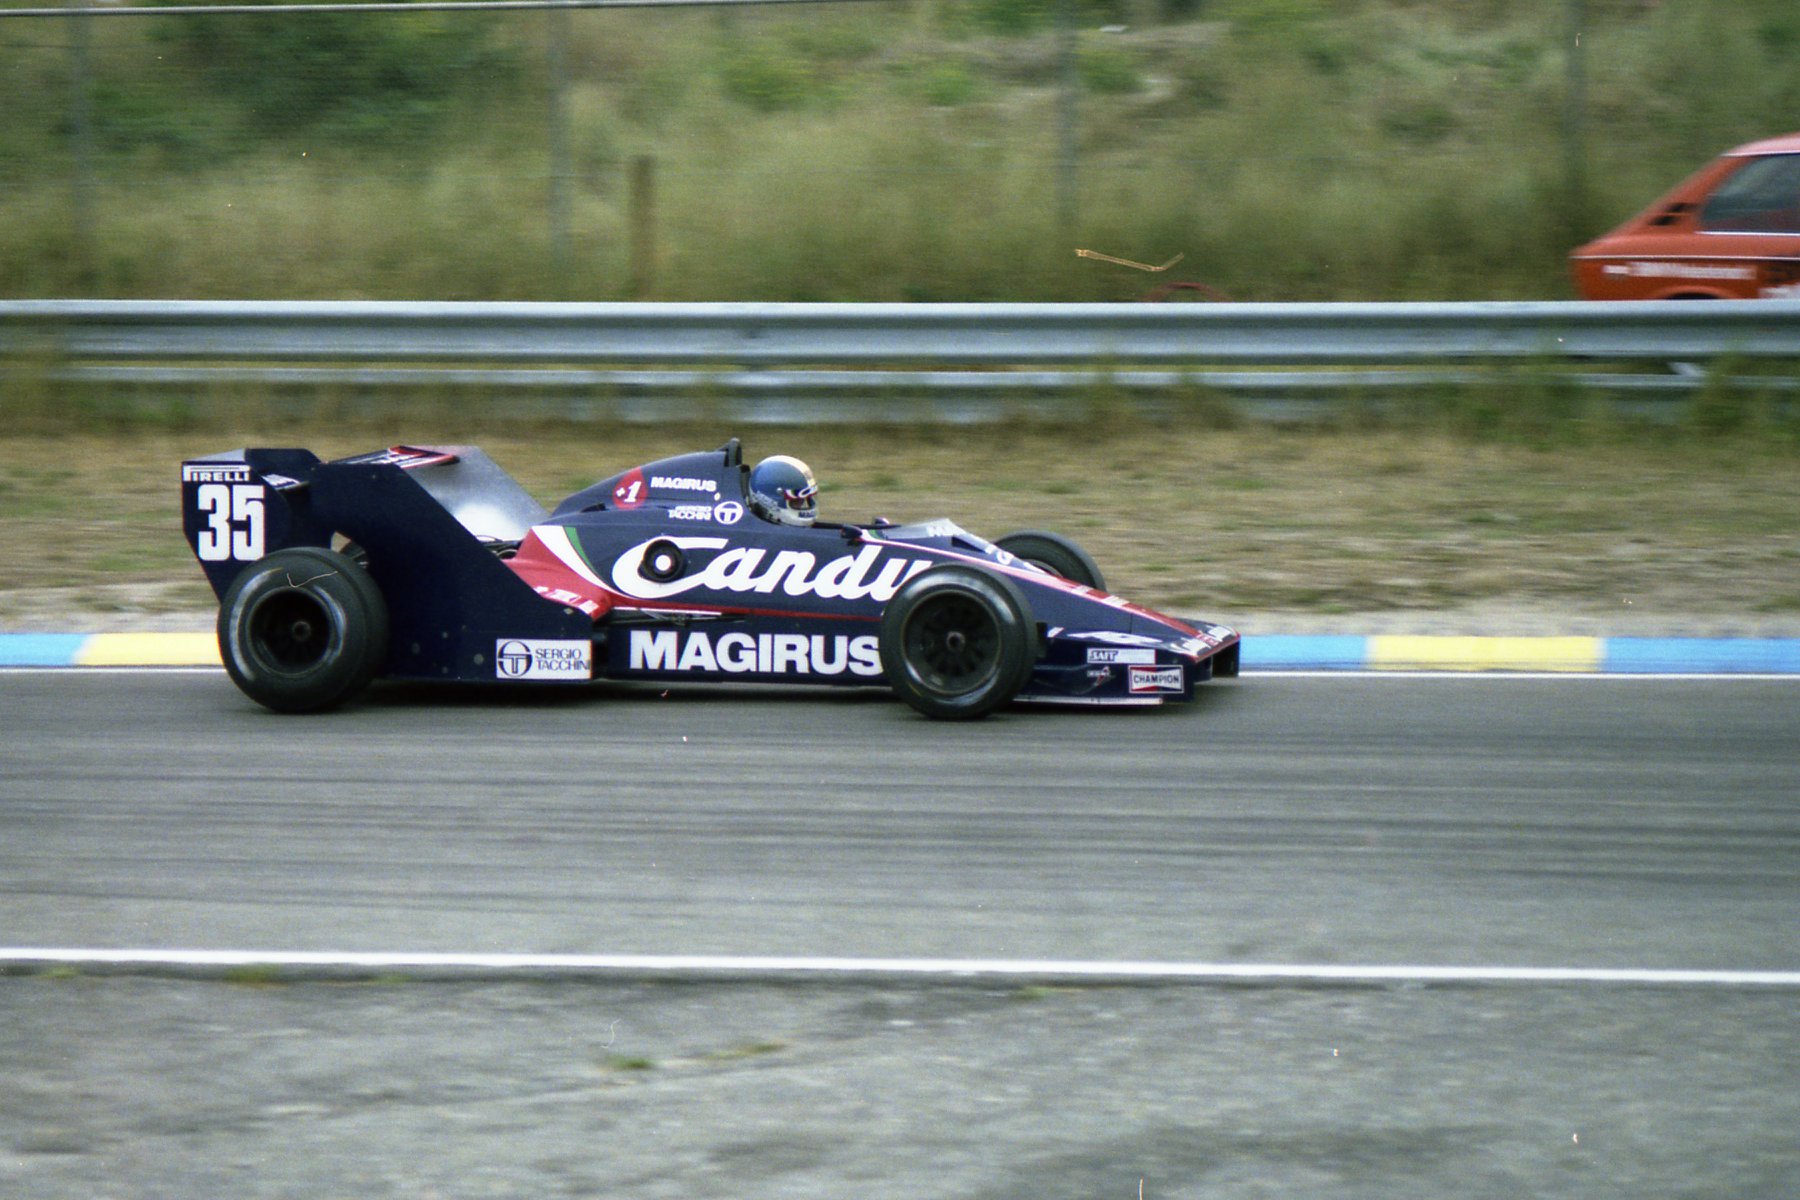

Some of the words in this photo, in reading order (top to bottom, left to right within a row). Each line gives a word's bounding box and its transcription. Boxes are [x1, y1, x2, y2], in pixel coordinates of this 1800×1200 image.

[183, 465, 250, 481] PIRELLI
[651, 476, 717, 492] MAGIRUS
[198, 484, 265, 561] 35
[535, 648, 581, 659] SERGIO
[630, 630, 883, 676] MAGIRUS
[1133, 674, 1179, 684] CHAMPION
